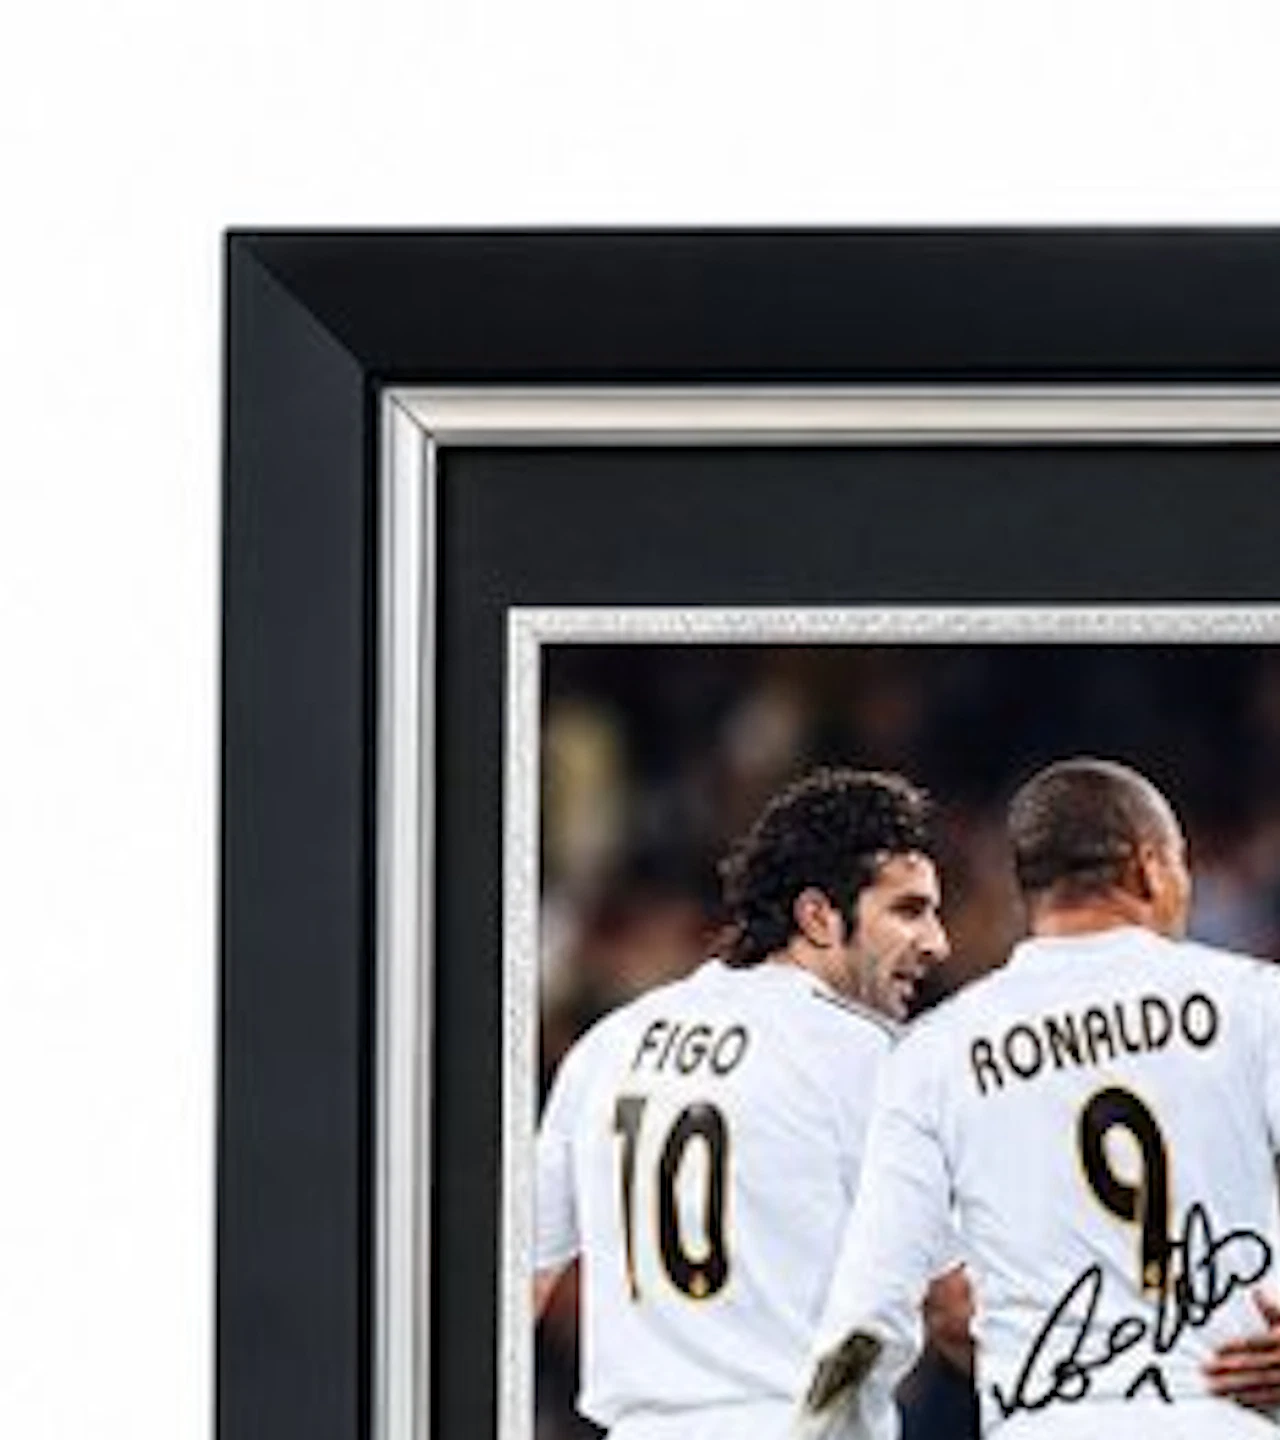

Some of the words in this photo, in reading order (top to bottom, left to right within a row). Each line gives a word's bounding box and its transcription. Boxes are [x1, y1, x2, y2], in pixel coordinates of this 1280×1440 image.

[630, 1018, 750, 1077] FIGO
[969, 992, 1220, 1095] RONALDO
[611, 1092, 732, 1303] 10
[1077, 1084, 1173, 1301] 9
